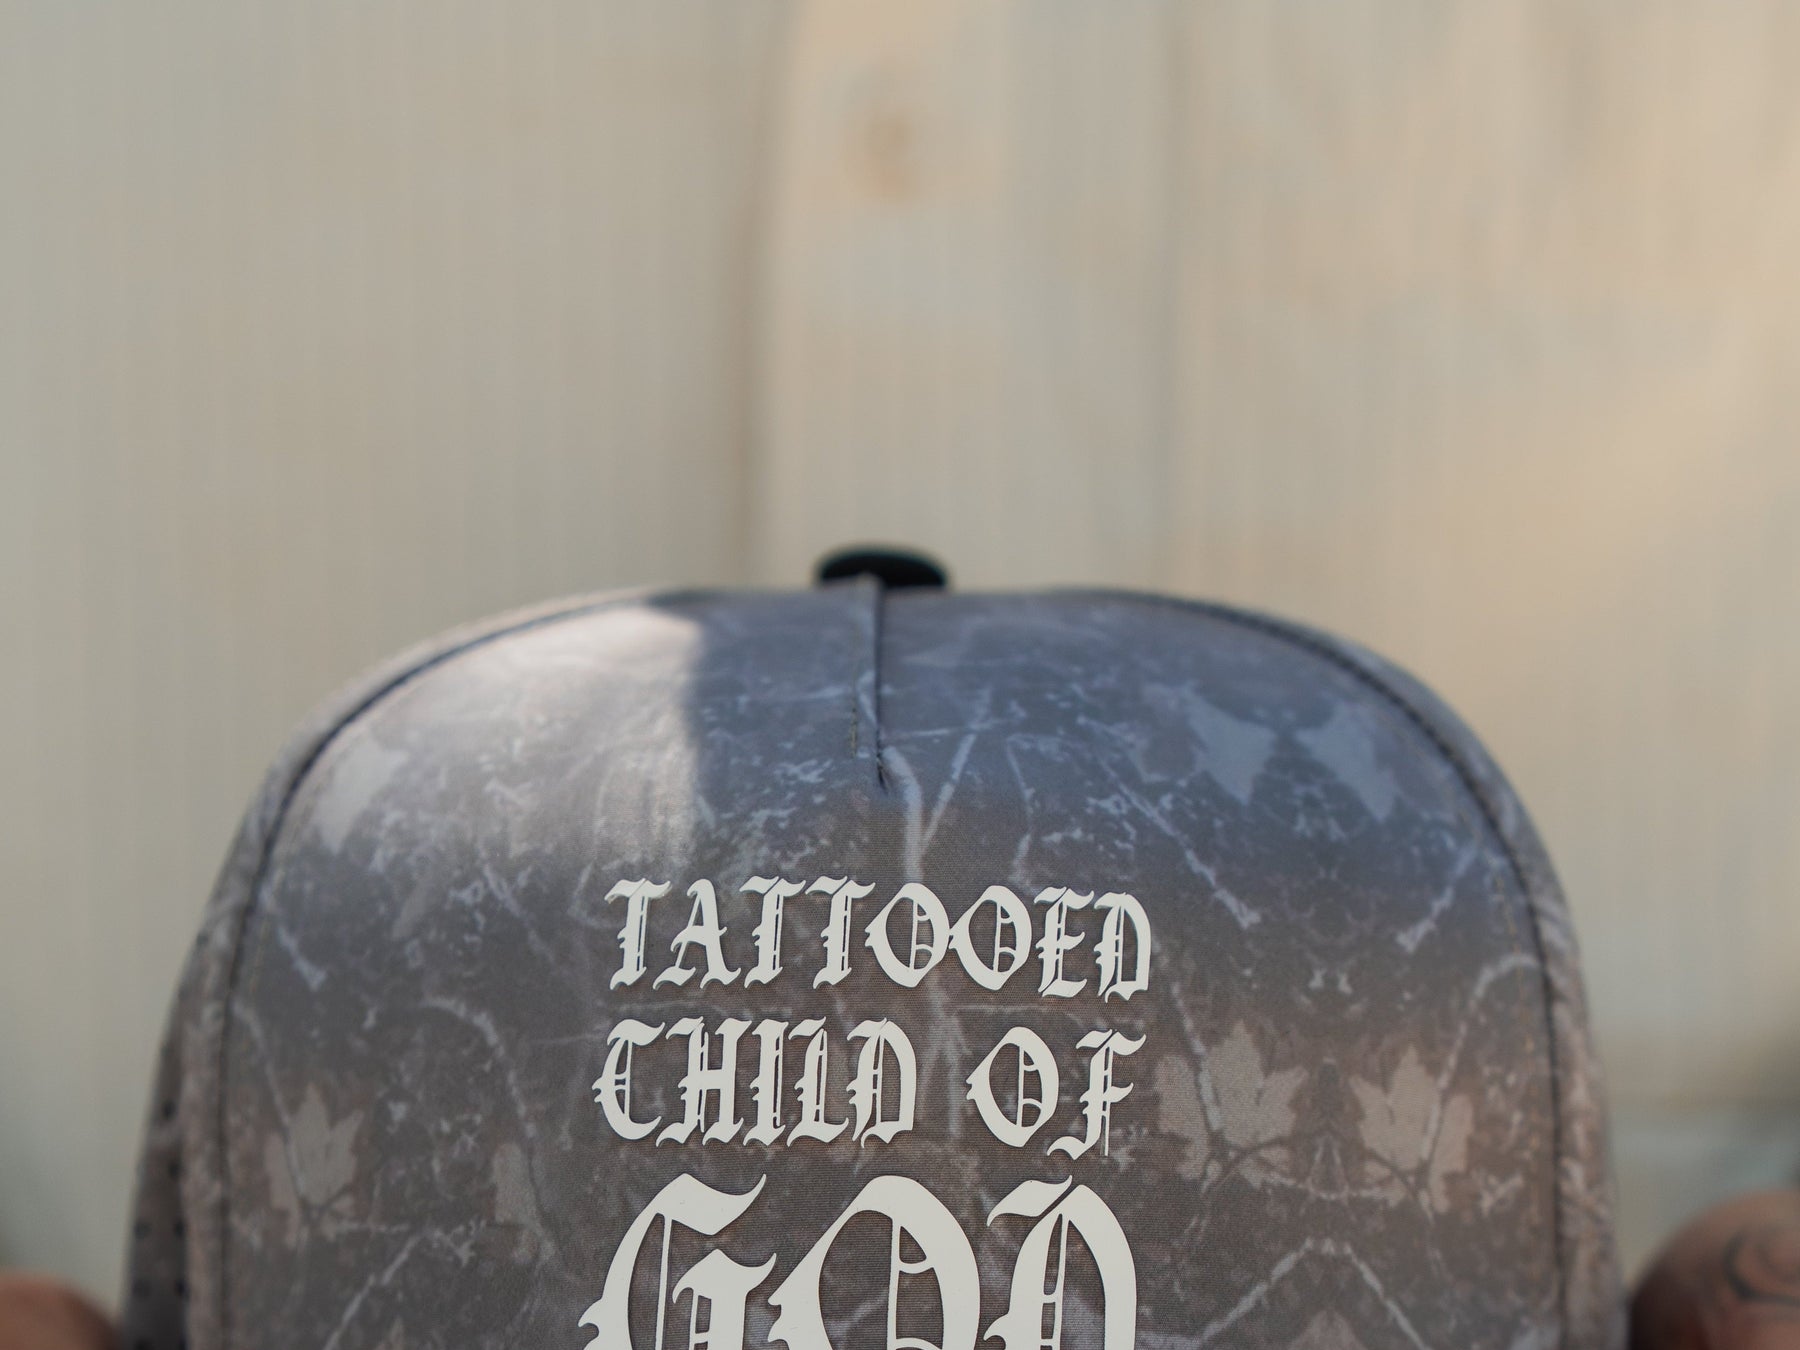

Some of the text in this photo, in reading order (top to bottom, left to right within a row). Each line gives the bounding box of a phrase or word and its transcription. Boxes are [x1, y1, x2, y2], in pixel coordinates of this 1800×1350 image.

[604, 875, 1151, 1003] TATTOOED
[592, 1016, 1147, 1160] CHILD OF
